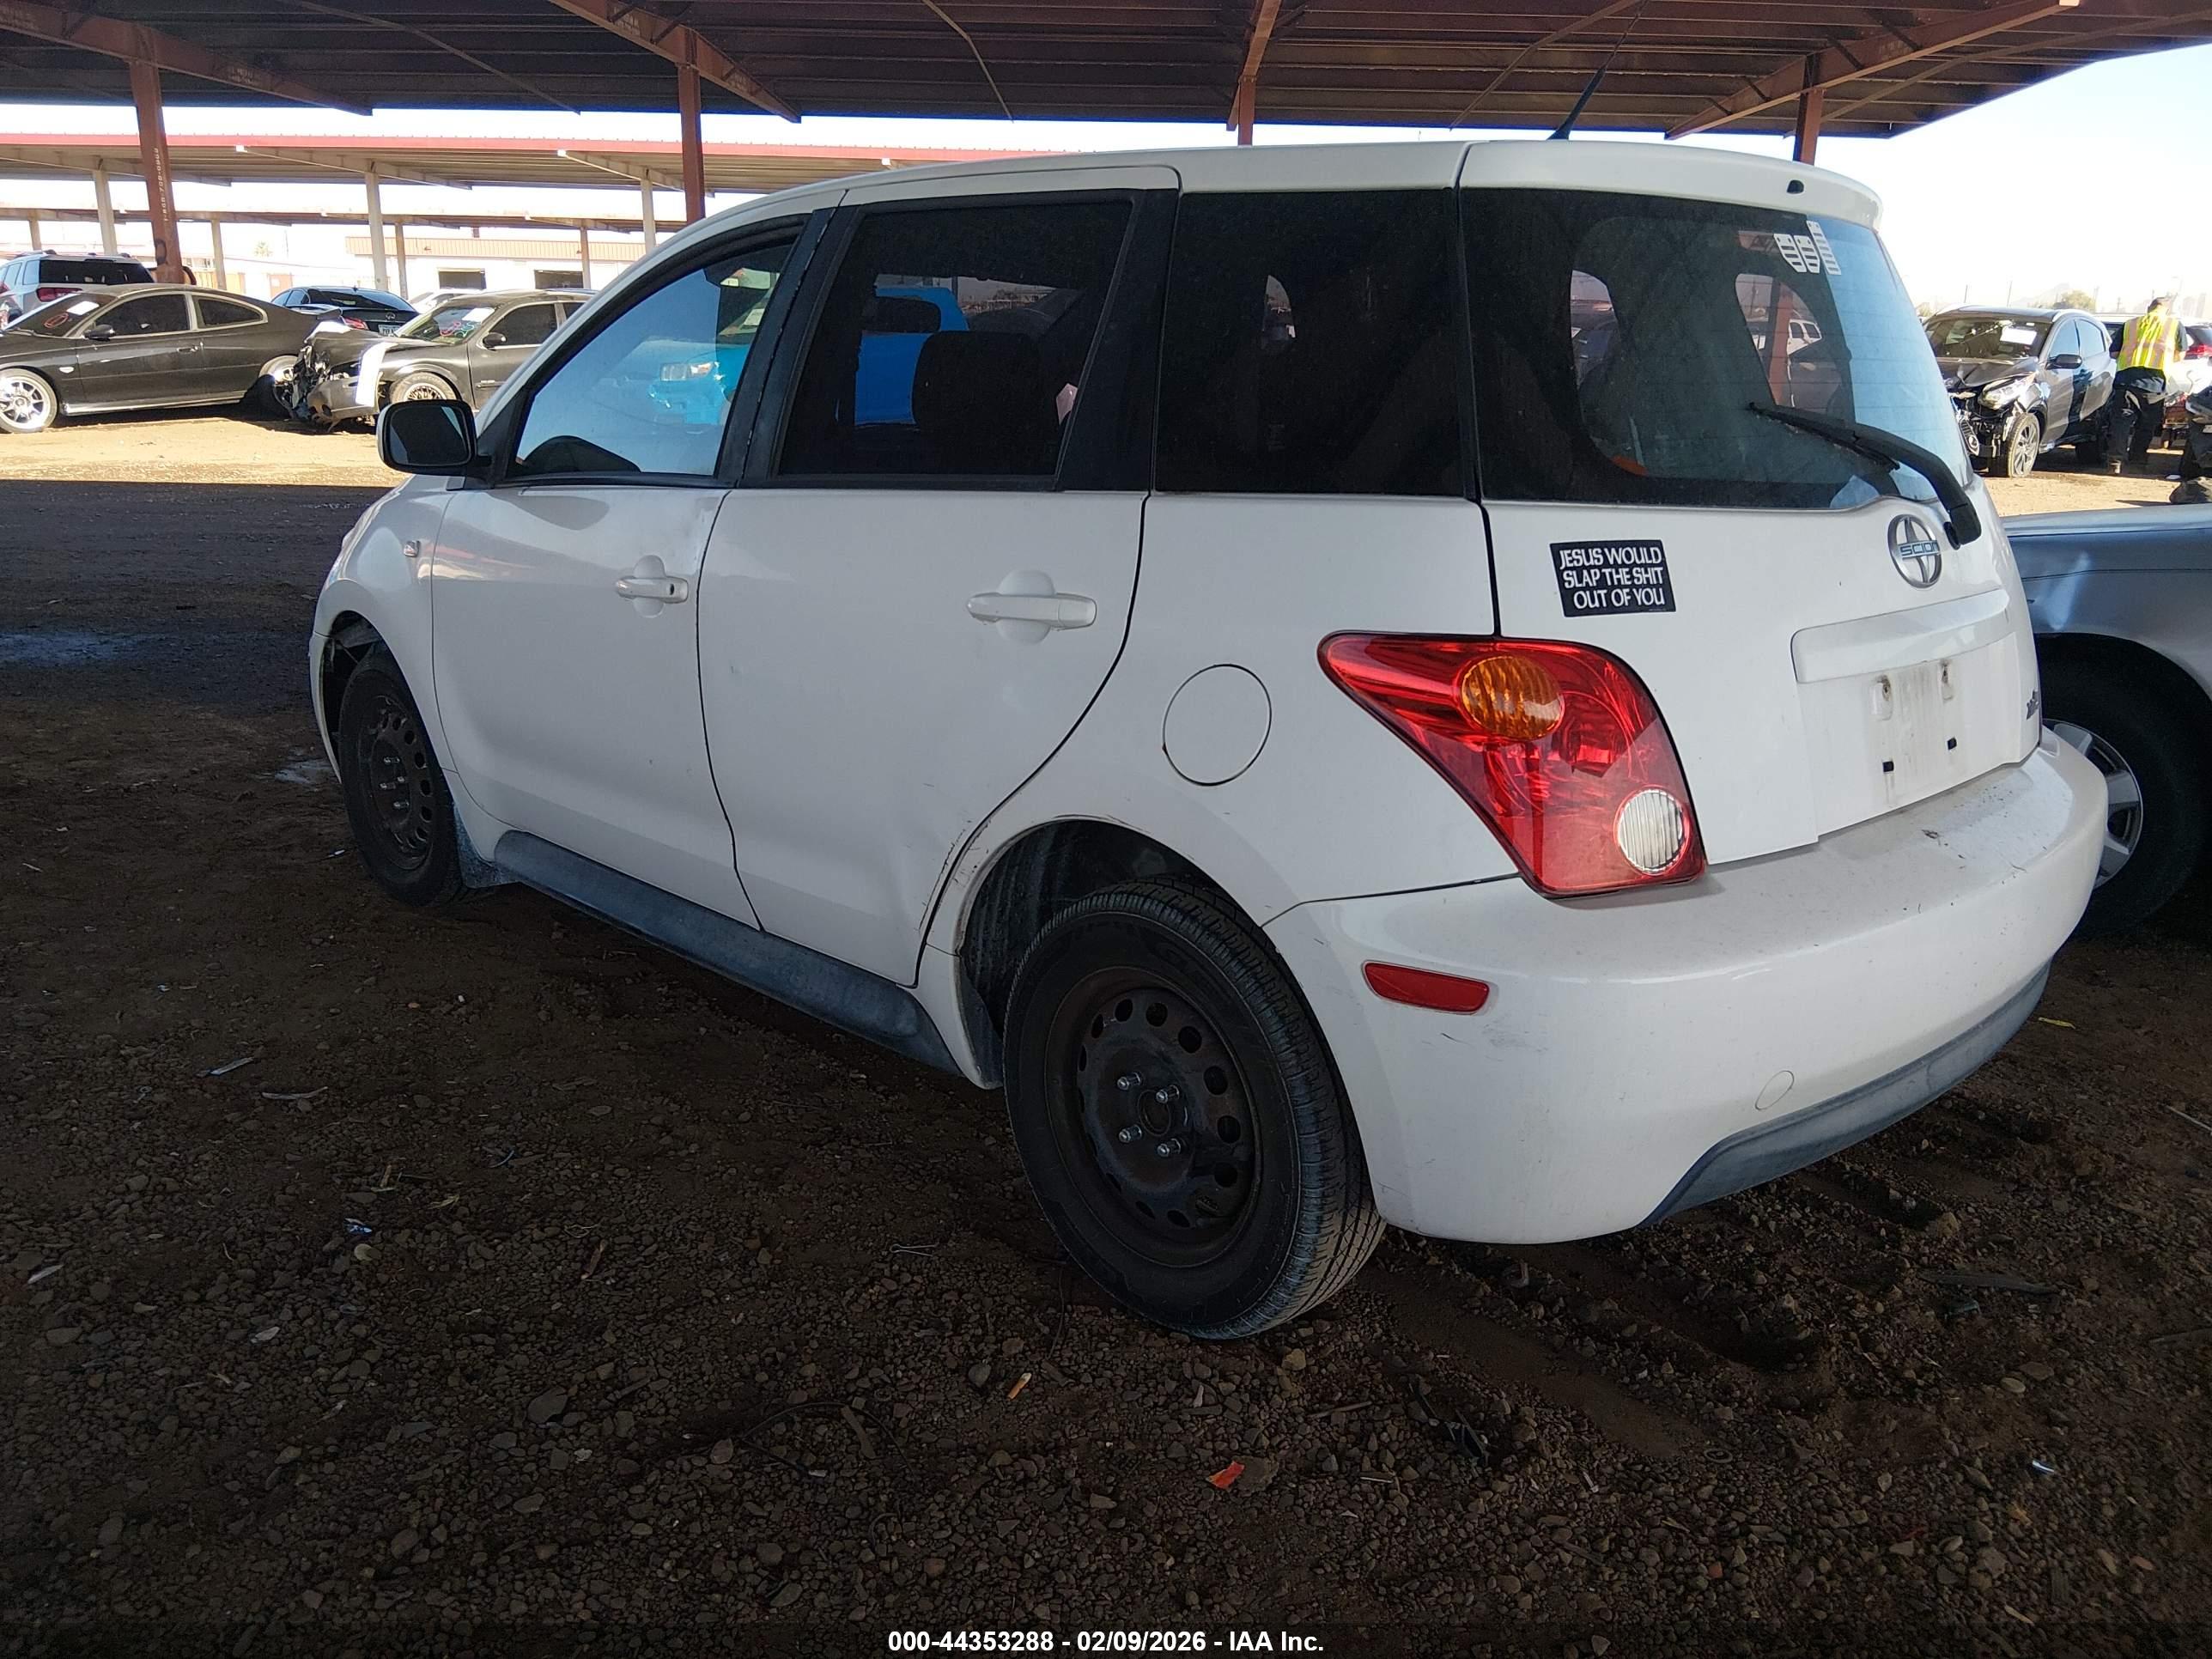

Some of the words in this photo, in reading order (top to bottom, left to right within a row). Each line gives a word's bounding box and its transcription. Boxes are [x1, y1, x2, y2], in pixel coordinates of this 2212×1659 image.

[1559, 548, 1604, 569] JESUS
[1604, 546, 1662, 565] WOULD
[1563, 568, 1601, 589] SLAP
[1601, 568, 1632, 586] THE
[1632, 567, 1663, 585] SHIT
[1573, 589, 1607, 610] OUT
[1611, 588, 1632, 607] OF
[1632, 587, 1666, 606] YOU
